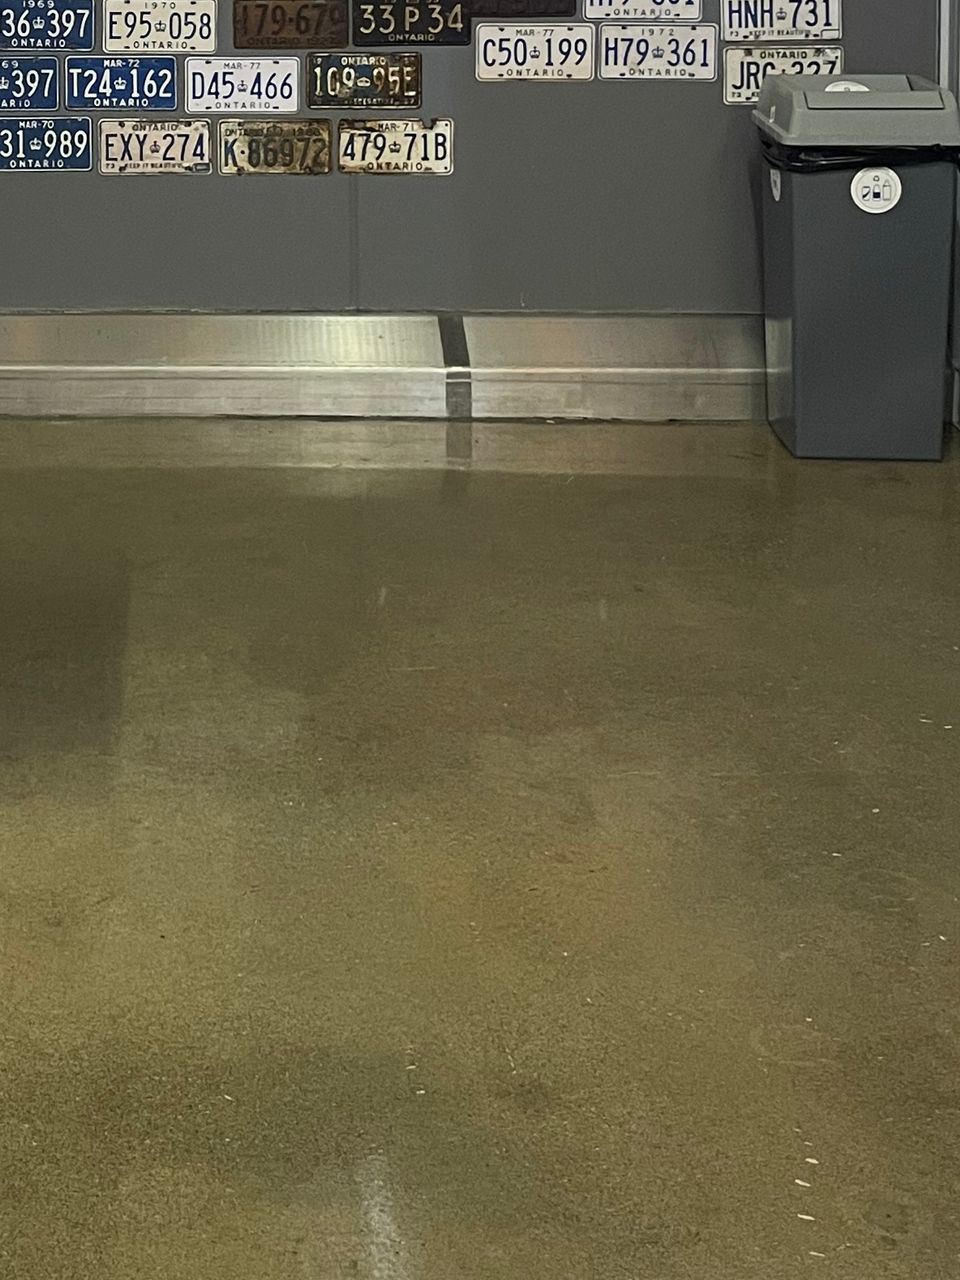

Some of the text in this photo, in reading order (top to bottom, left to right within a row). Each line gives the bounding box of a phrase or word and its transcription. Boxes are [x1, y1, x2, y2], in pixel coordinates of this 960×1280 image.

[47, 9, 90, 38] 397
[728, 0, 774, 28] HNH
[223, 62, 261, 70] MAR-77
[760, 51, 808, 59] ONTARIO
[70, 69, 173, 98] T24 162
[192, 72, 293, 100] D45 466
[43, 130, 88, 158] 989
[106, 134, 205, 162] EXY 274
[343, 133, 447, 162] 479 71B
[367, 162, 423, 170] ONTARIO
